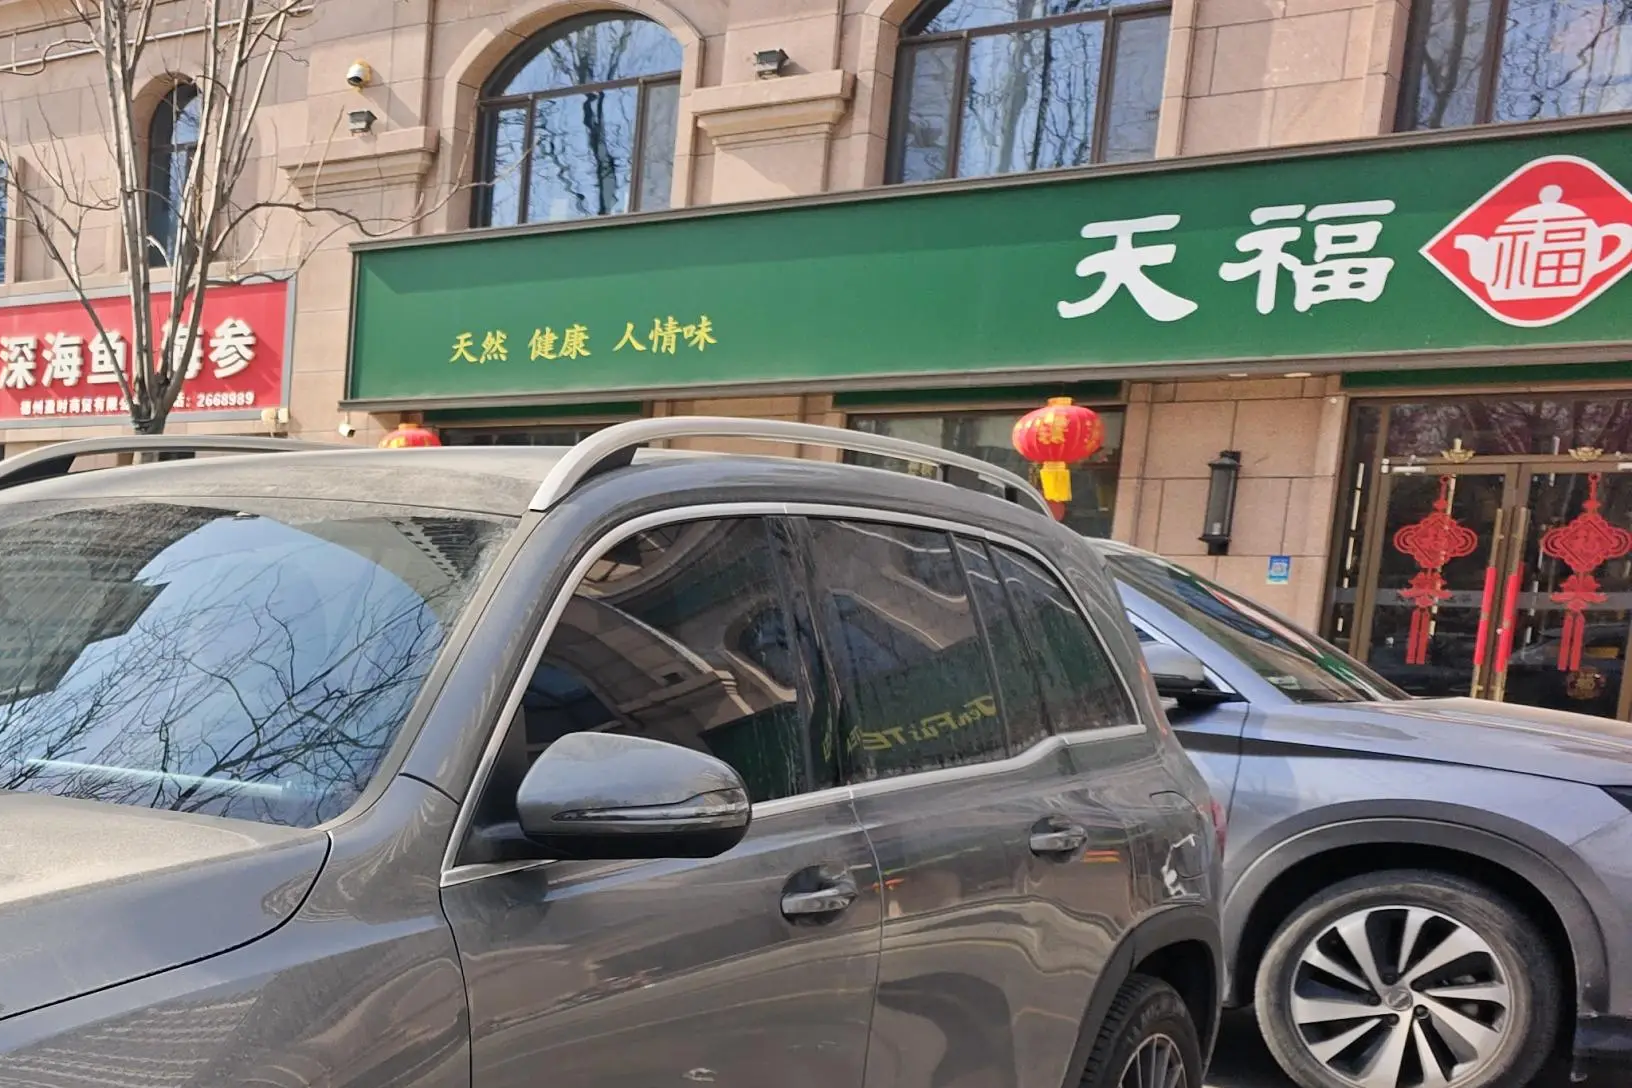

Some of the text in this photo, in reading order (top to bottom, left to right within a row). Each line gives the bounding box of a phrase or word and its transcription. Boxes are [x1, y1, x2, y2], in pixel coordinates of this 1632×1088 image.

[1057, 199, 1397, 322] 天福
[1491, 216, 1590, 290] 福
[449, 314, 718, 364] 天然 健康 人情味
